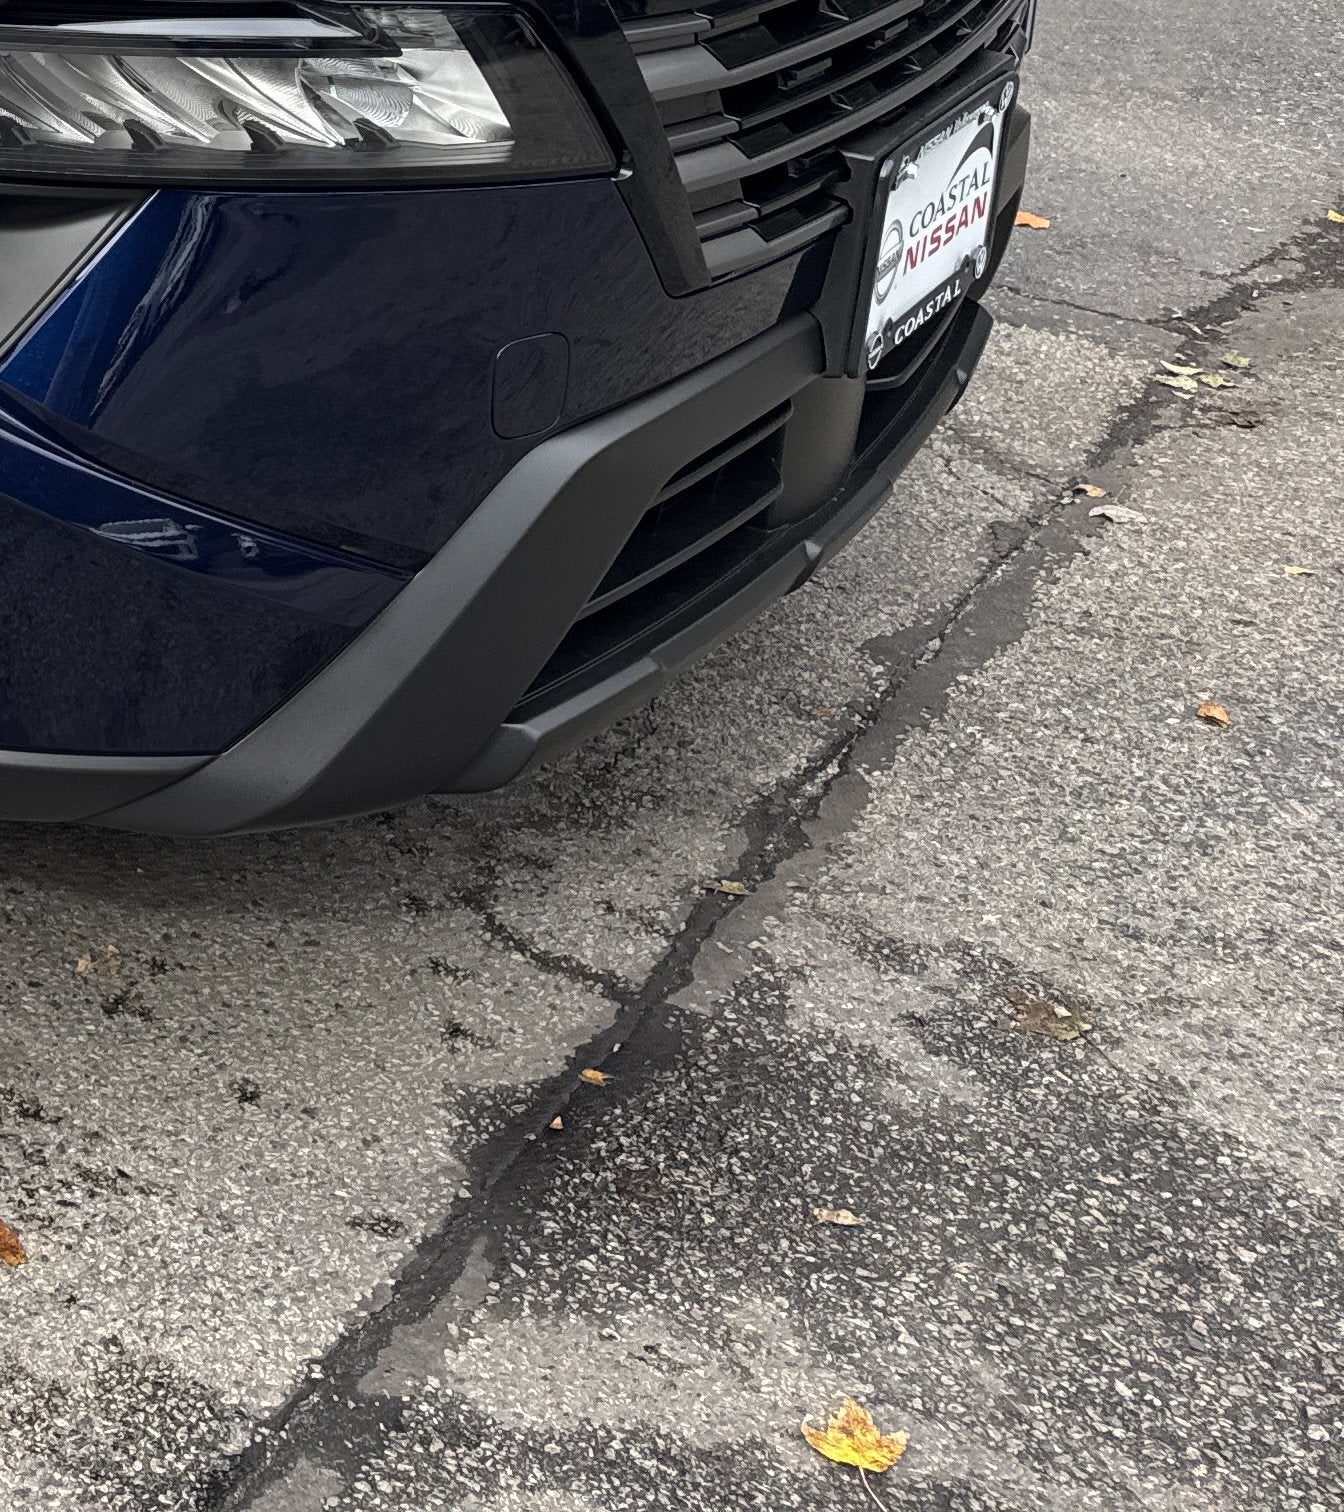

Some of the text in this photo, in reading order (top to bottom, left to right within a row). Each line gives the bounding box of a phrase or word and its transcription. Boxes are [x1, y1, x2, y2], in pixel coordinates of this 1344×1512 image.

[902, 190, 988, 277] NISSAN
[909, 160, 991, 238] COASTAL
[894, 278, 962, 346] COASTAL
